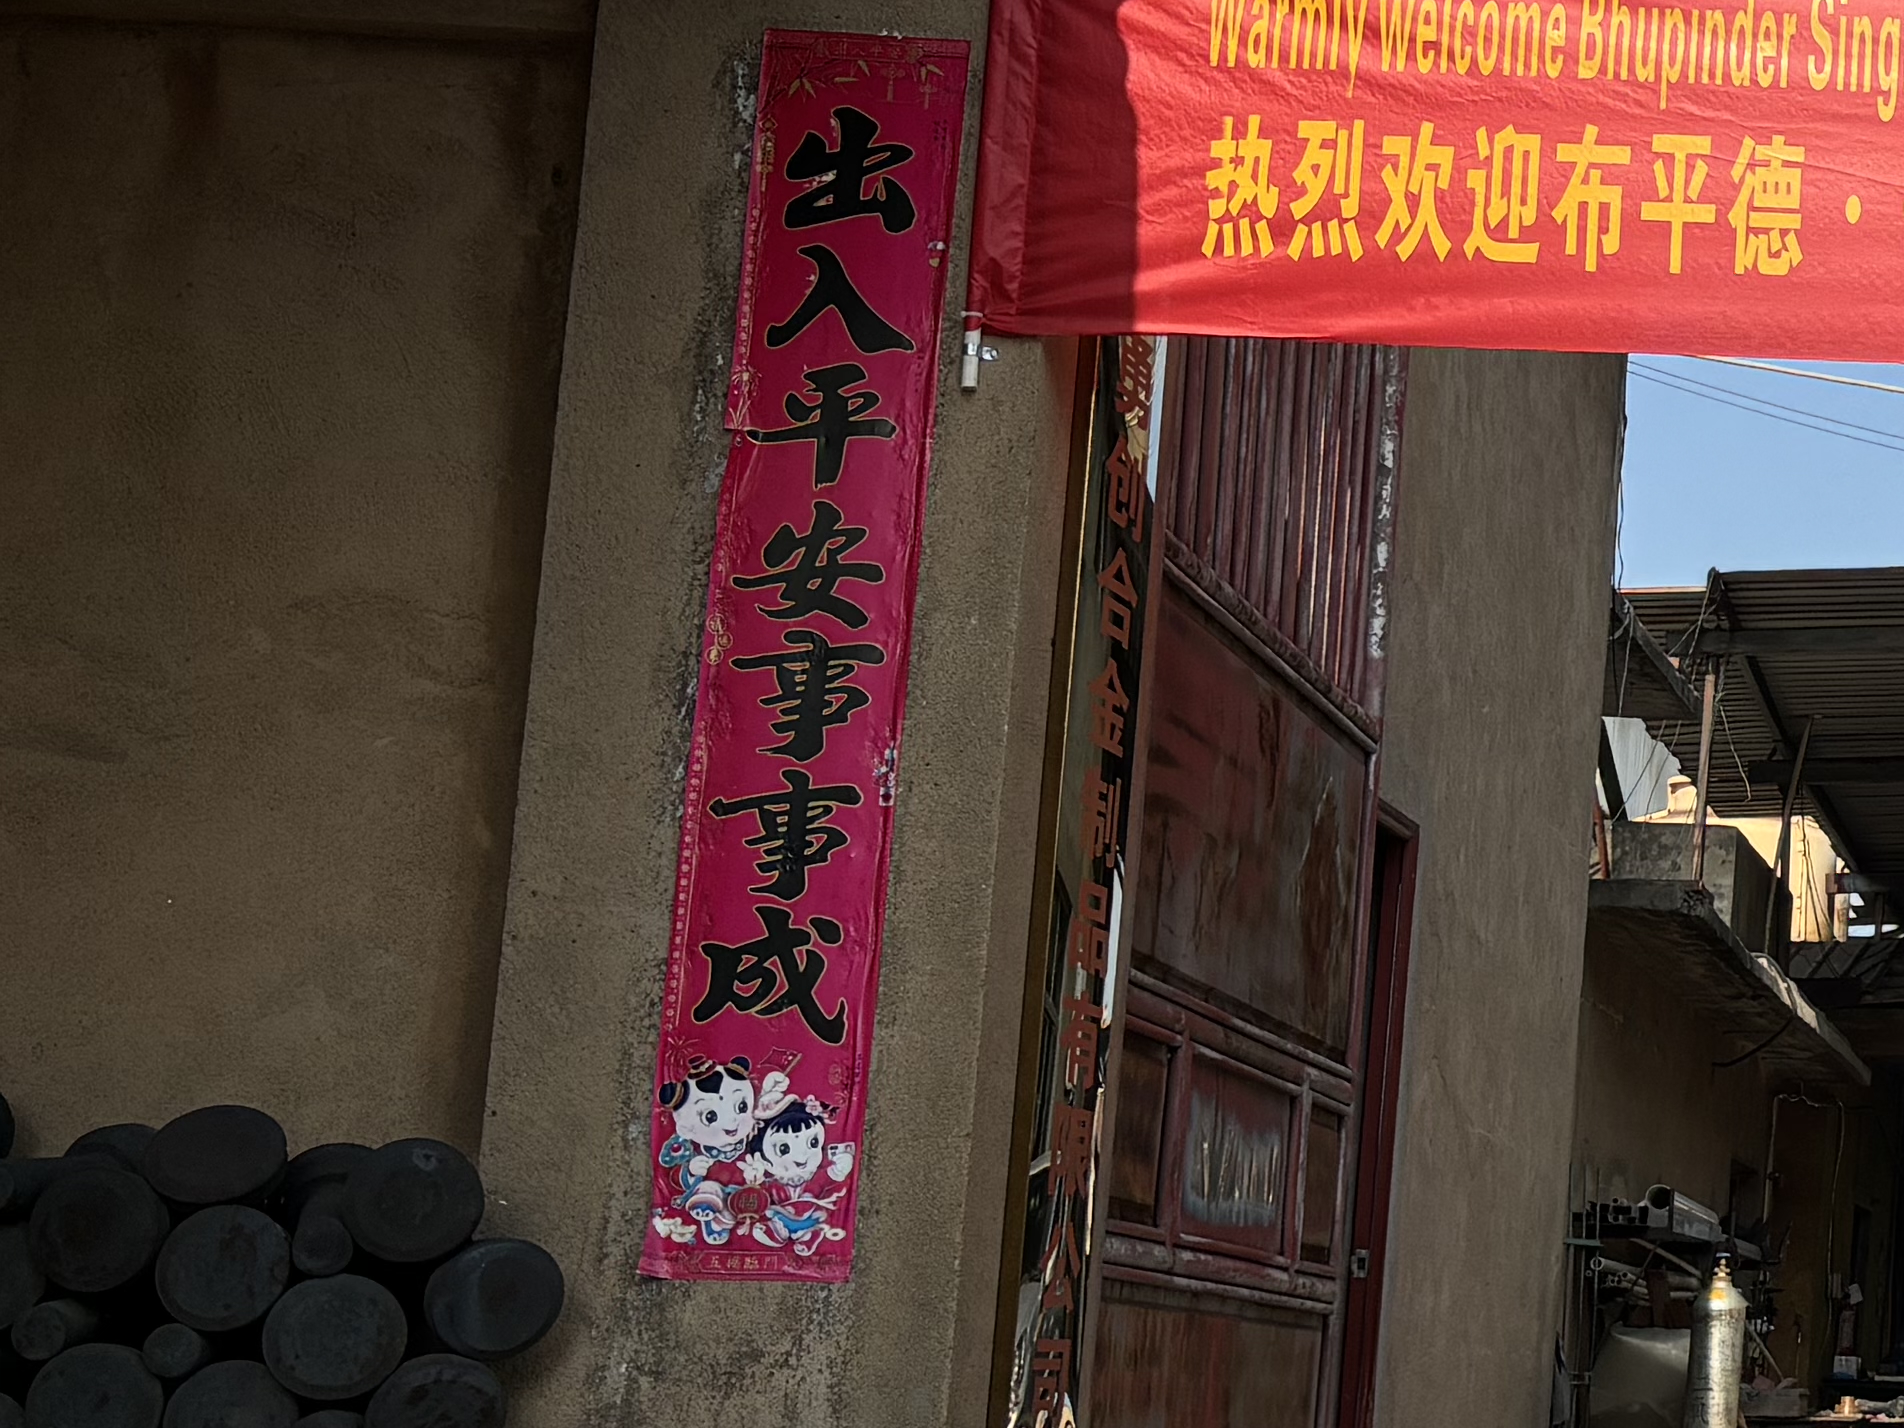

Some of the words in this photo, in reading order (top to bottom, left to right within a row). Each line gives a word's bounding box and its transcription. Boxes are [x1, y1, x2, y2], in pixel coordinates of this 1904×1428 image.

[692, 105, 916, 1044] 出入平安事事成
